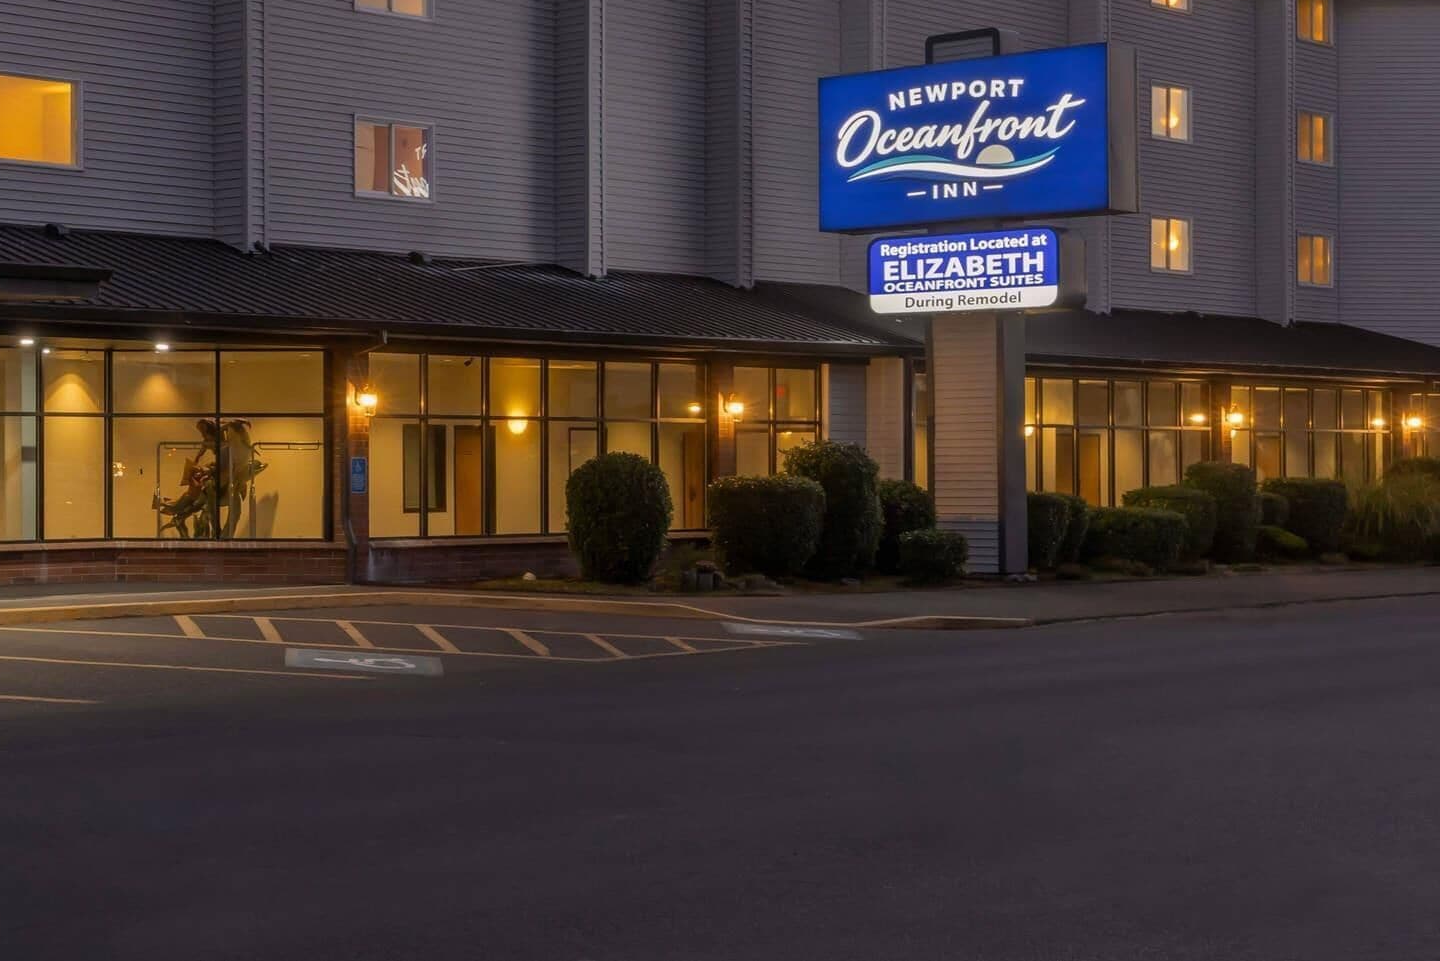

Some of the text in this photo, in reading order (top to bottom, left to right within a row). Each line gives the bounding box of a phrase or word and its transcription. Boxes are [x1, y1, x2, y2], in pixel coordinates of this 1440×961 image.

[888, 79, 1024, 110] NEWPORT
[836, 94, 1086, 167] Oceanfront
[932, 181, 977, 199] INN
[880, 234, 1047, 257] Registration Located at
[883, 251, 1044, 281] ELIZABETH
[884, 274, 1043, 293] OCEANFRONT SUITES
[905, 291, 1022, 309] During Remodel
